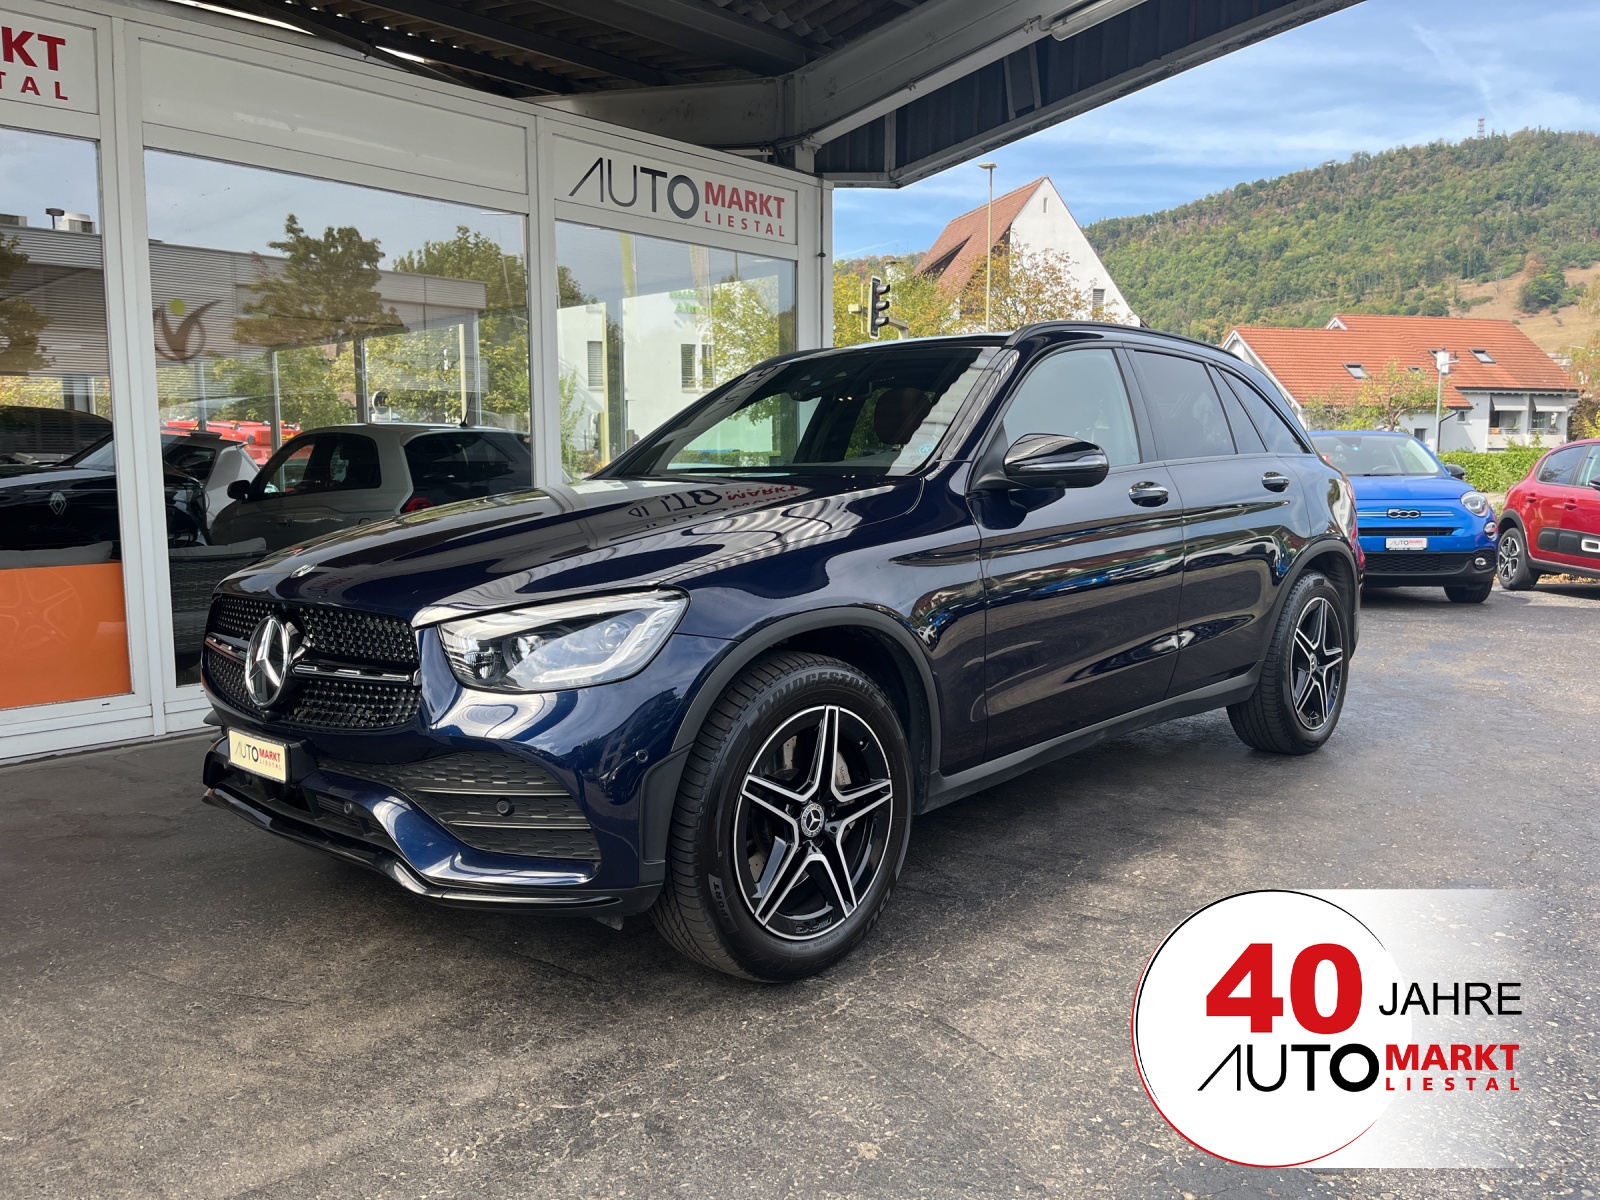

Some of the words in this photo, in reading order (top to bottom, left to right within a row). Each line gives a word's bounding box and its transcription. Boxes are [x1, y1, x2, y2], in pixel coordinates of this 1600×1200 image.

[1, 26, 66, 72] KT
[568, 157, 700, 219] AUTO
[704, 181, 785, 219] MARKT
[704, 210, 785, 237] LIESTAL
[1388, 508, 1421, 519] 500
[259, 747, 281, 763] MARKT
